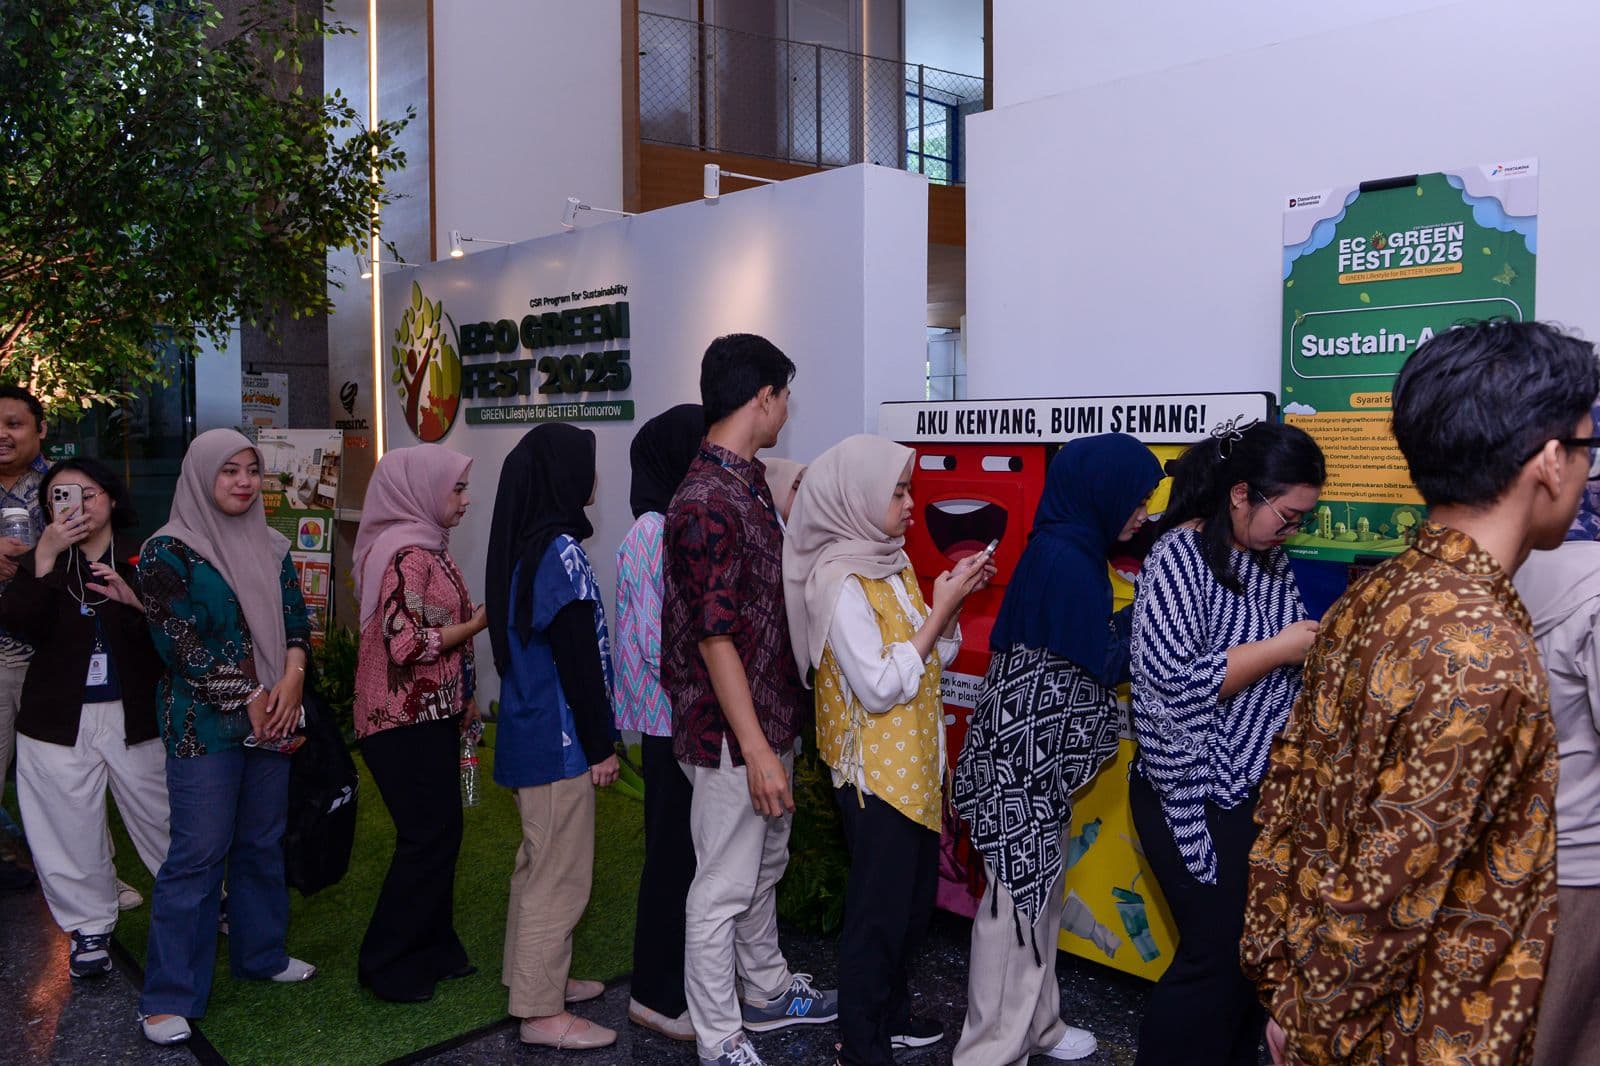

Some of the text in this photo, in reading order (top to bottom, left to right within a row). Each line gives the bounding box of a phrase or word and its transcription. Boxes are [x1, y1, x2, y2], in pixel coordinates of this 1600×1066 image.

[1388, 225, 1464, 248] GREEN
[1338, 241, 1463, 272] FEST 2025
[529, 284, 628, 308] CSR Program for Sustainability
[460, 301, 630, 356] ECO GREEN
[462, 349, 632, 399] FEST 2025
[1356, 396, 1383, 406] Syarat
[480, 404, 622, 422] GREEN Lifestyle for BETTER Tomorrow
[916, 404, 1207, 438] AKU KENYANG, BUMI SENANG!
[952, 676, 971, 690] kami
[785, 996, 813, 1017] N
